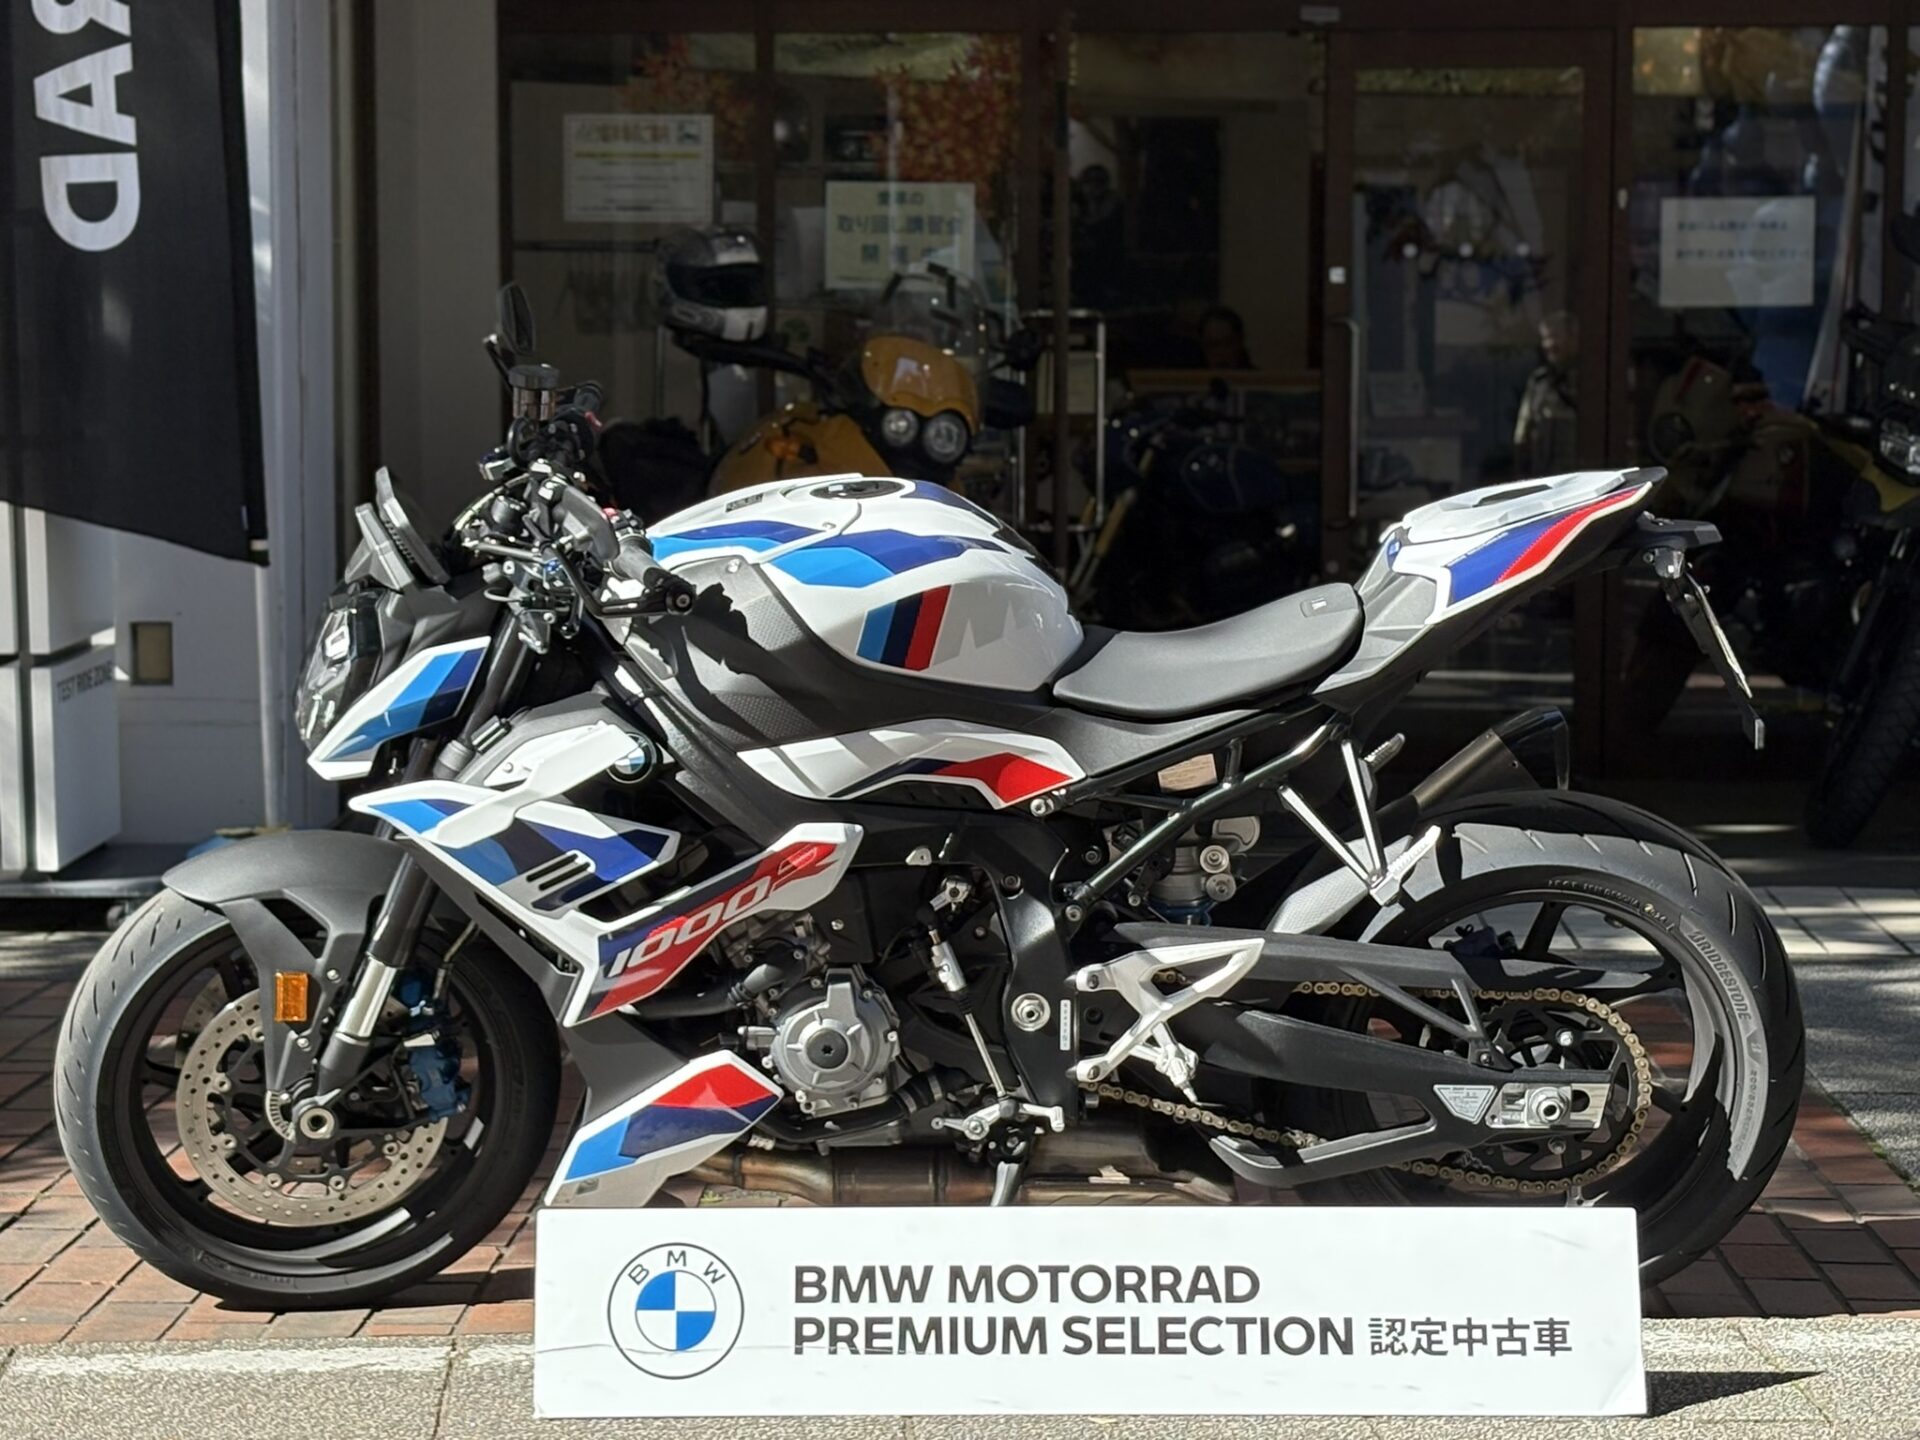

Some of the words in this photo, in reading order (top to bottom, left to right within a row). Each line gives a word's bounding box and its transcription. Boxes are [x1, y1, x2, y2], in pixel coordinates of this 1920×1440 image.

[77, 668, 93, 693] RIDE
[1687, 929, 1752, 1020] BRIDGESTONE
[627, 1250, 726, 1285] BMW
[794, 1265, 934, 1304] BMW
[948, 1265, 1261, 1304] MOTORRAD
[794, 1316, 1048, 1356] PREMIUM
[1063, 1316, 1355, 1356] SELECTION
[1367, 1317, 1573, 1357] 認定中古車
